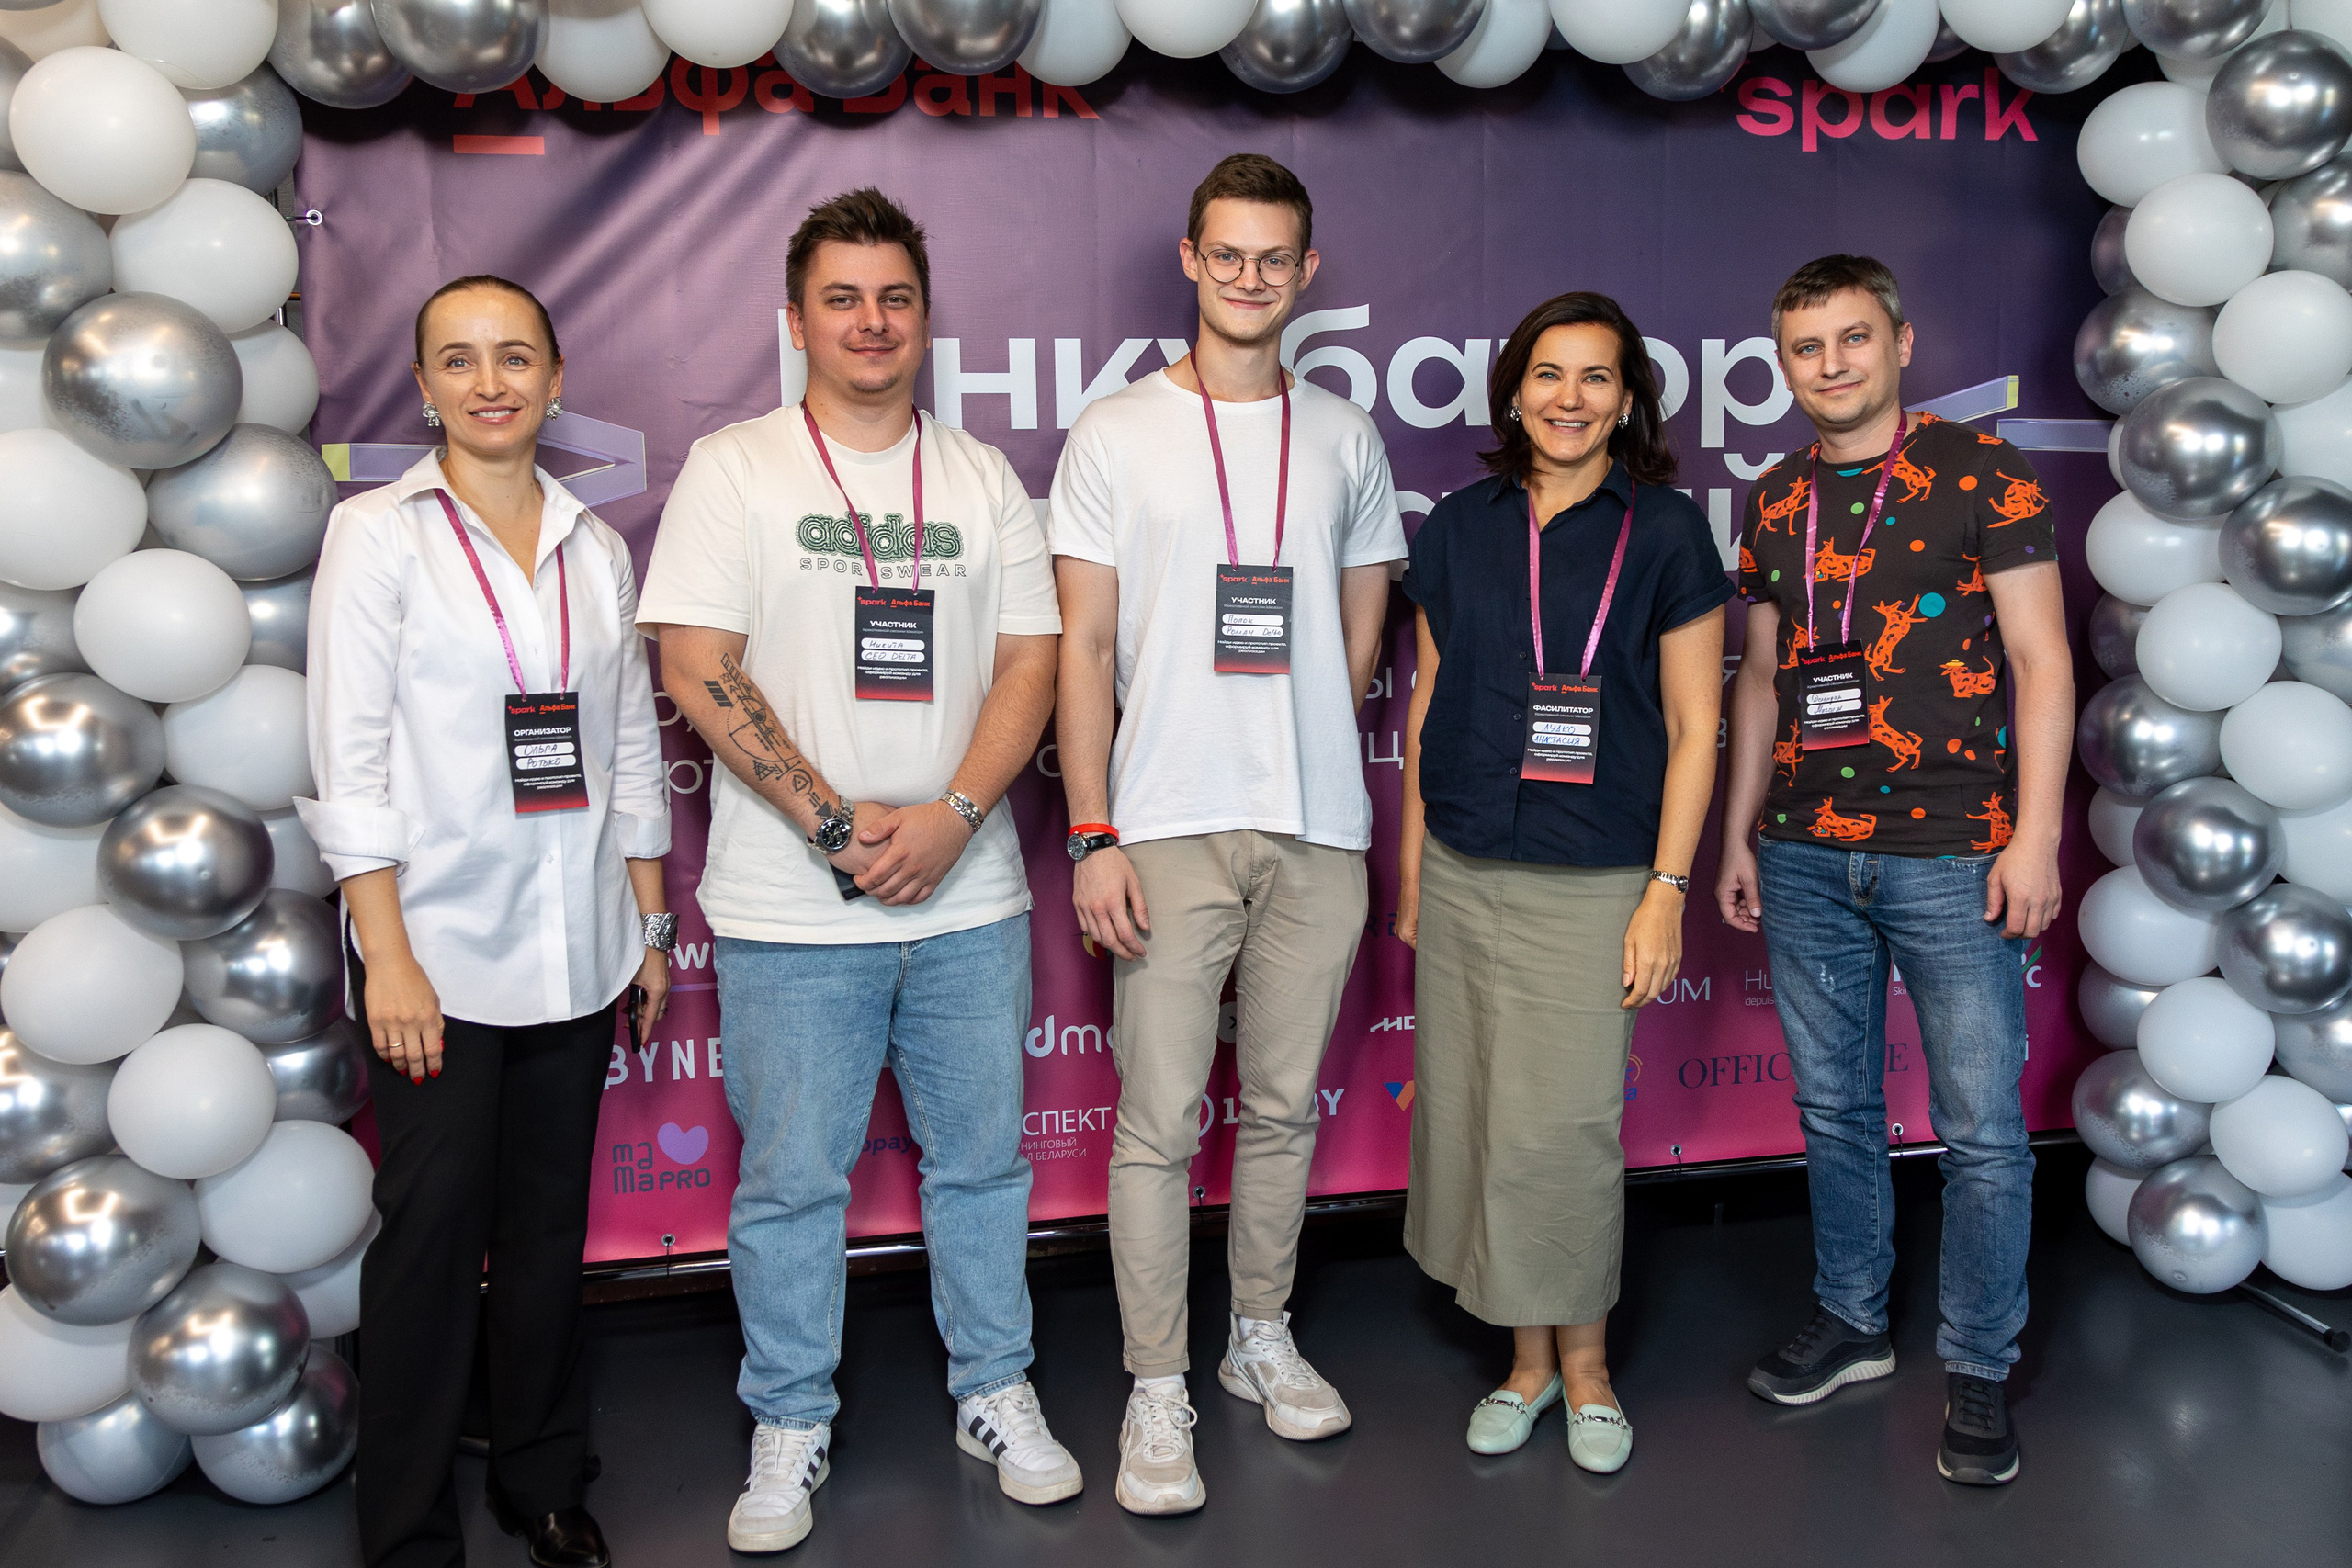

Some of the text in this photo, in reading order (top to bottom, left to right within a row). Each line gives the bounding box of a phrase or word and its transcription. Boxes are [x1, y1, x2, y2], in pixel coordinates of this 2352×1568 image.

[1736, 66, 2039, 152] spark
[799, 558, 967, 579] SPORSWEAR
[870, 620, 917, 629] УЧАСТНИК
[1813, 672, 1853, 683] УЧАСТНИК
[1532, 705, 1594, 714] ФАСИЛИТАТОР
[514, 727, 571, 737] ОРГАНИЗАТОР
[1019, 1136, 1077, 1152] НИНГОВЫЙ
[1035, 1148, 1087, 1161] БЕЛАРУСИ
